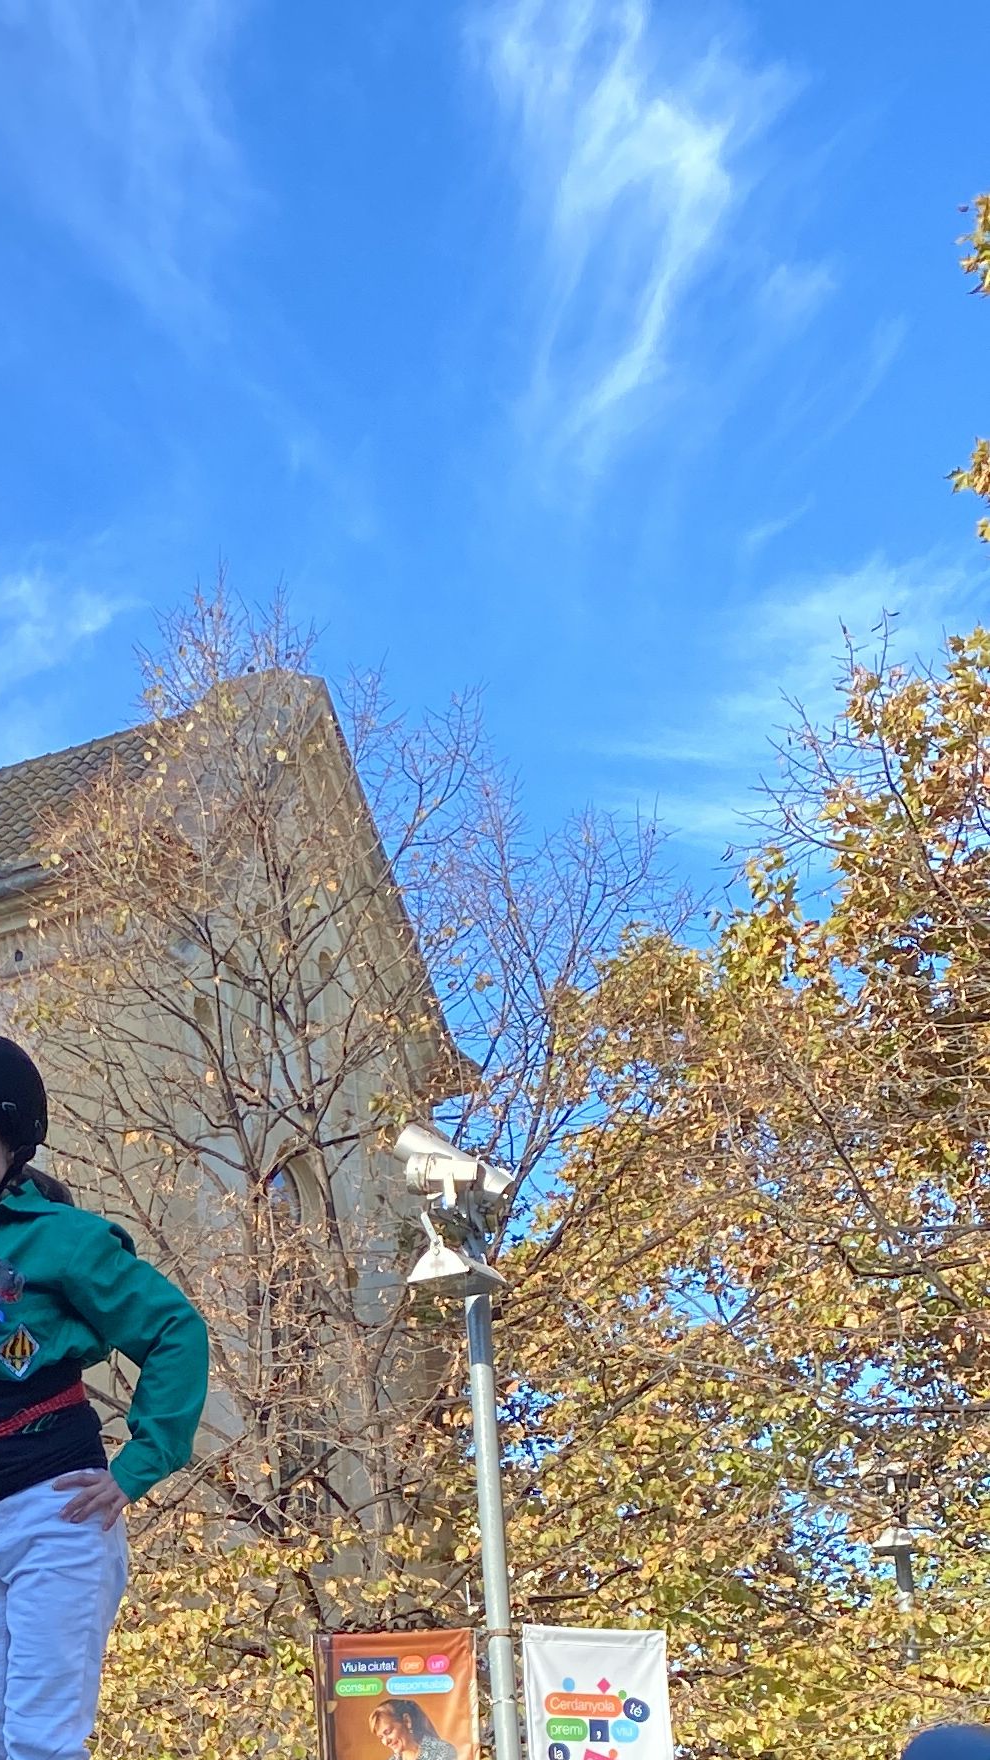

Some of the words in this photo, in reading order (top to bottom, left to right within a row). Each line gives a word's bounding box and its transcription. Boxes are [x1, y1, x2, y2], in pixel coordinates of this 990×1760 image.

[341, 1662, 357, 1673] Viu
[357, 1661, 367, 1672] la
[404, 1661, 421, 1671] per
[431, 1660, 444, 1669] un
[339, 1683, 378, 1693] consum
[390, 1678, 450, 1691] responsable
[549, 1696, 616, 1714] Cerdanyola
[629, 1702, 643, 1717] té
[550, 1724, 583, 1736] premi
[616, 1727, 633, 1737] viu
[554, 1746, 564, 1760] la
